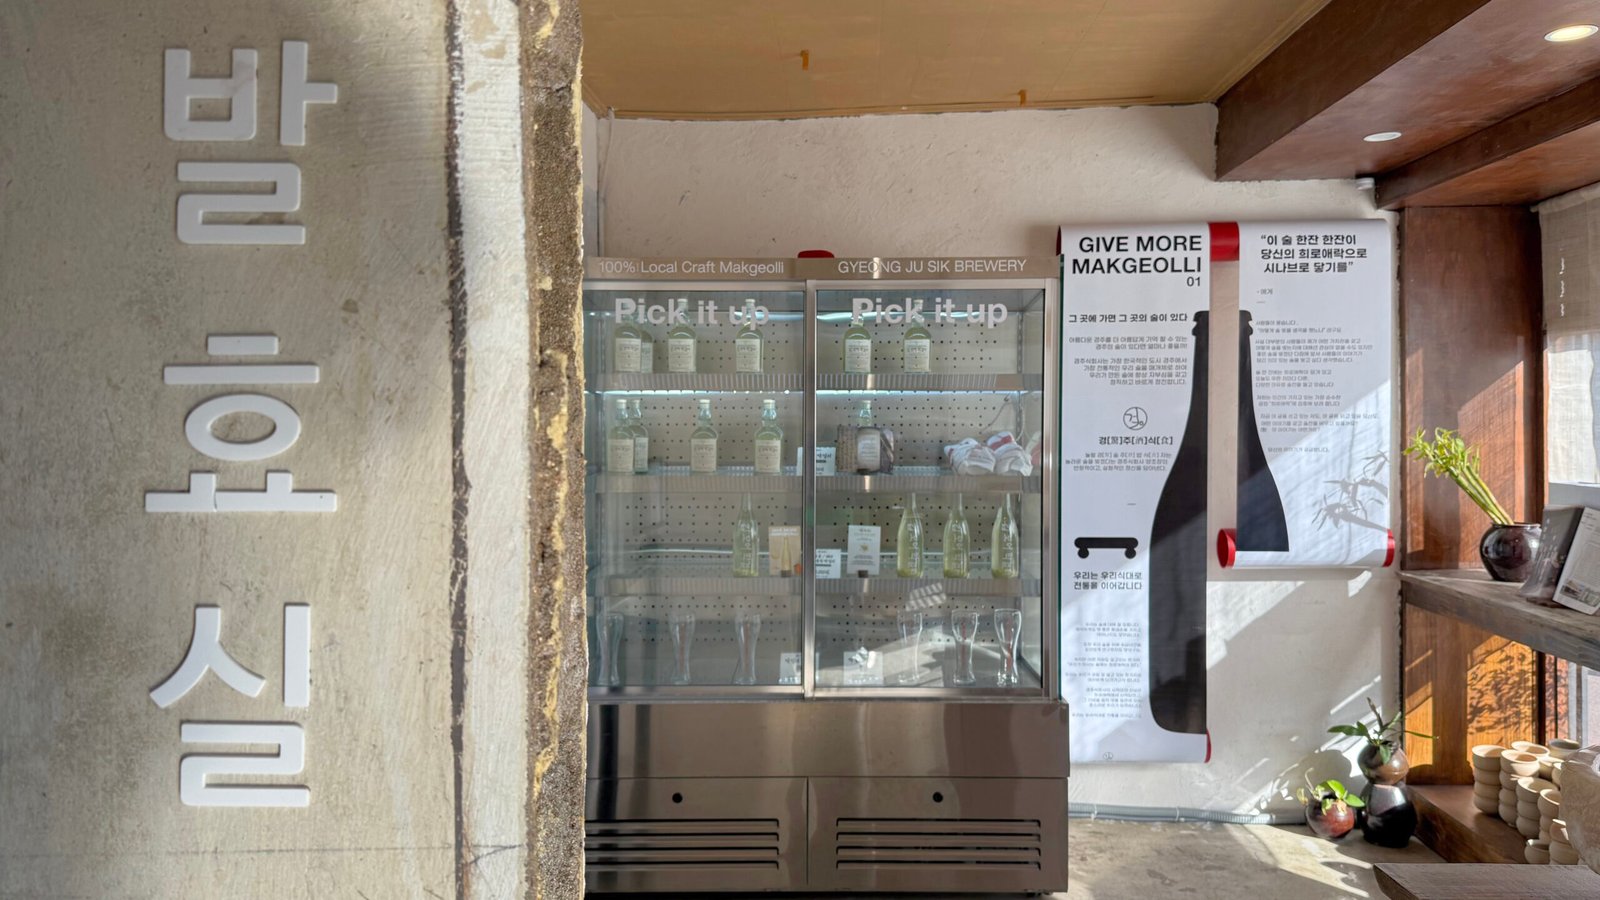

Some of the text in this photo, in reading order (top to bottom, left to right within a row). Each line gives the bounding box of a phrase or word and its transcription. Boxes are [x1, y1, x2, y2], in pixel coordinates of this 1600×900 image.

[1079, 235, 1202, 252] GIVE MORE
[1282, 235, 1292, 245] 술
[1296, 235, 1319, 245] 한잔
[1323, 235, 1356, 245] 한잔이
[1261, 248, 1367, 259] 당신의 희로애락으로
[599, 260, 784, 276] 100% Local Craft Makgeolli
[838, 260, 1027, 274] GYEONG JU SIK BREWERY
[1072, 257, 1201, 274] MAKGEOLLI
[1264, 262, 1309, 273] 시나브로
[1186, 276, 1201, 286] 01
[615, 298, 769, 330] Pick it up
[852, 297, 1008, 328] Pick it up
[1080, 314, 1097, 323] 곳에
[1099, 314, 1116, 323] 가면
[1130, 314, 1148, 322] 곳의
[1150, 314, 1168, 322] 술이
[1170, 314, 1188, 322] 있다
[145, 40, 338, 808] 발효실
[1074, 571, 1142, 580] 우리는 우리식대로
[1100, 581, 1142, 590] 이어갑니다
